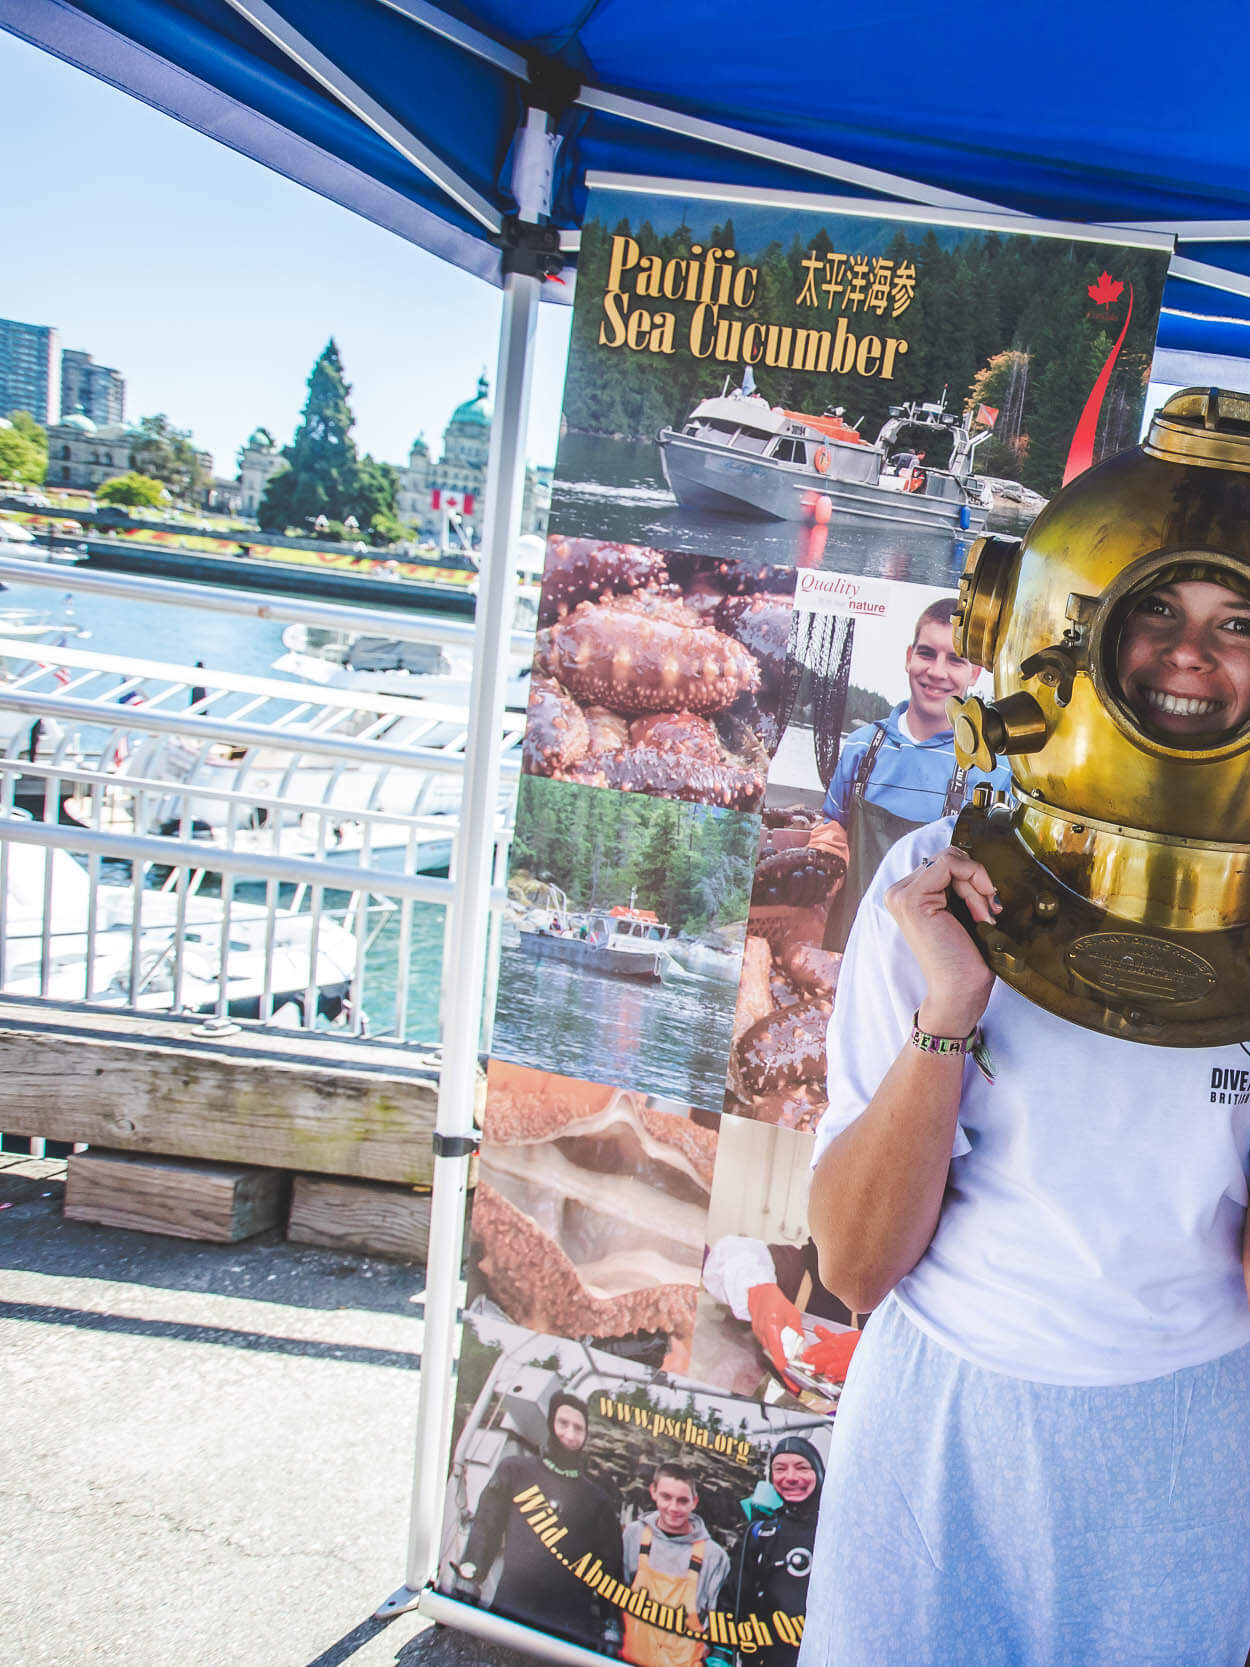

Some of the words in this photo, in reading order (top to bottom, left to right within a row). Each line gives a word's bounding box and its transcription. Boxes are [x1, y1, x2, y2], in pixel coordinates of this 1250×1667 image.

[605, 235, 758, 308] Pacific
[796, 249, 916, 318] 太平洋海参
[599, 290, 676, 354] Sea
[690, 301, 909, 380] Cucumber
[801, 573, 861, 600] Quality
[849, 600, 886, 613] nature
[1210, 1067, 1249, 1092] DIVE
[600, 1397, 753, 1465] www.pscha.org
[772, 1610, 807, 1648] Qu
